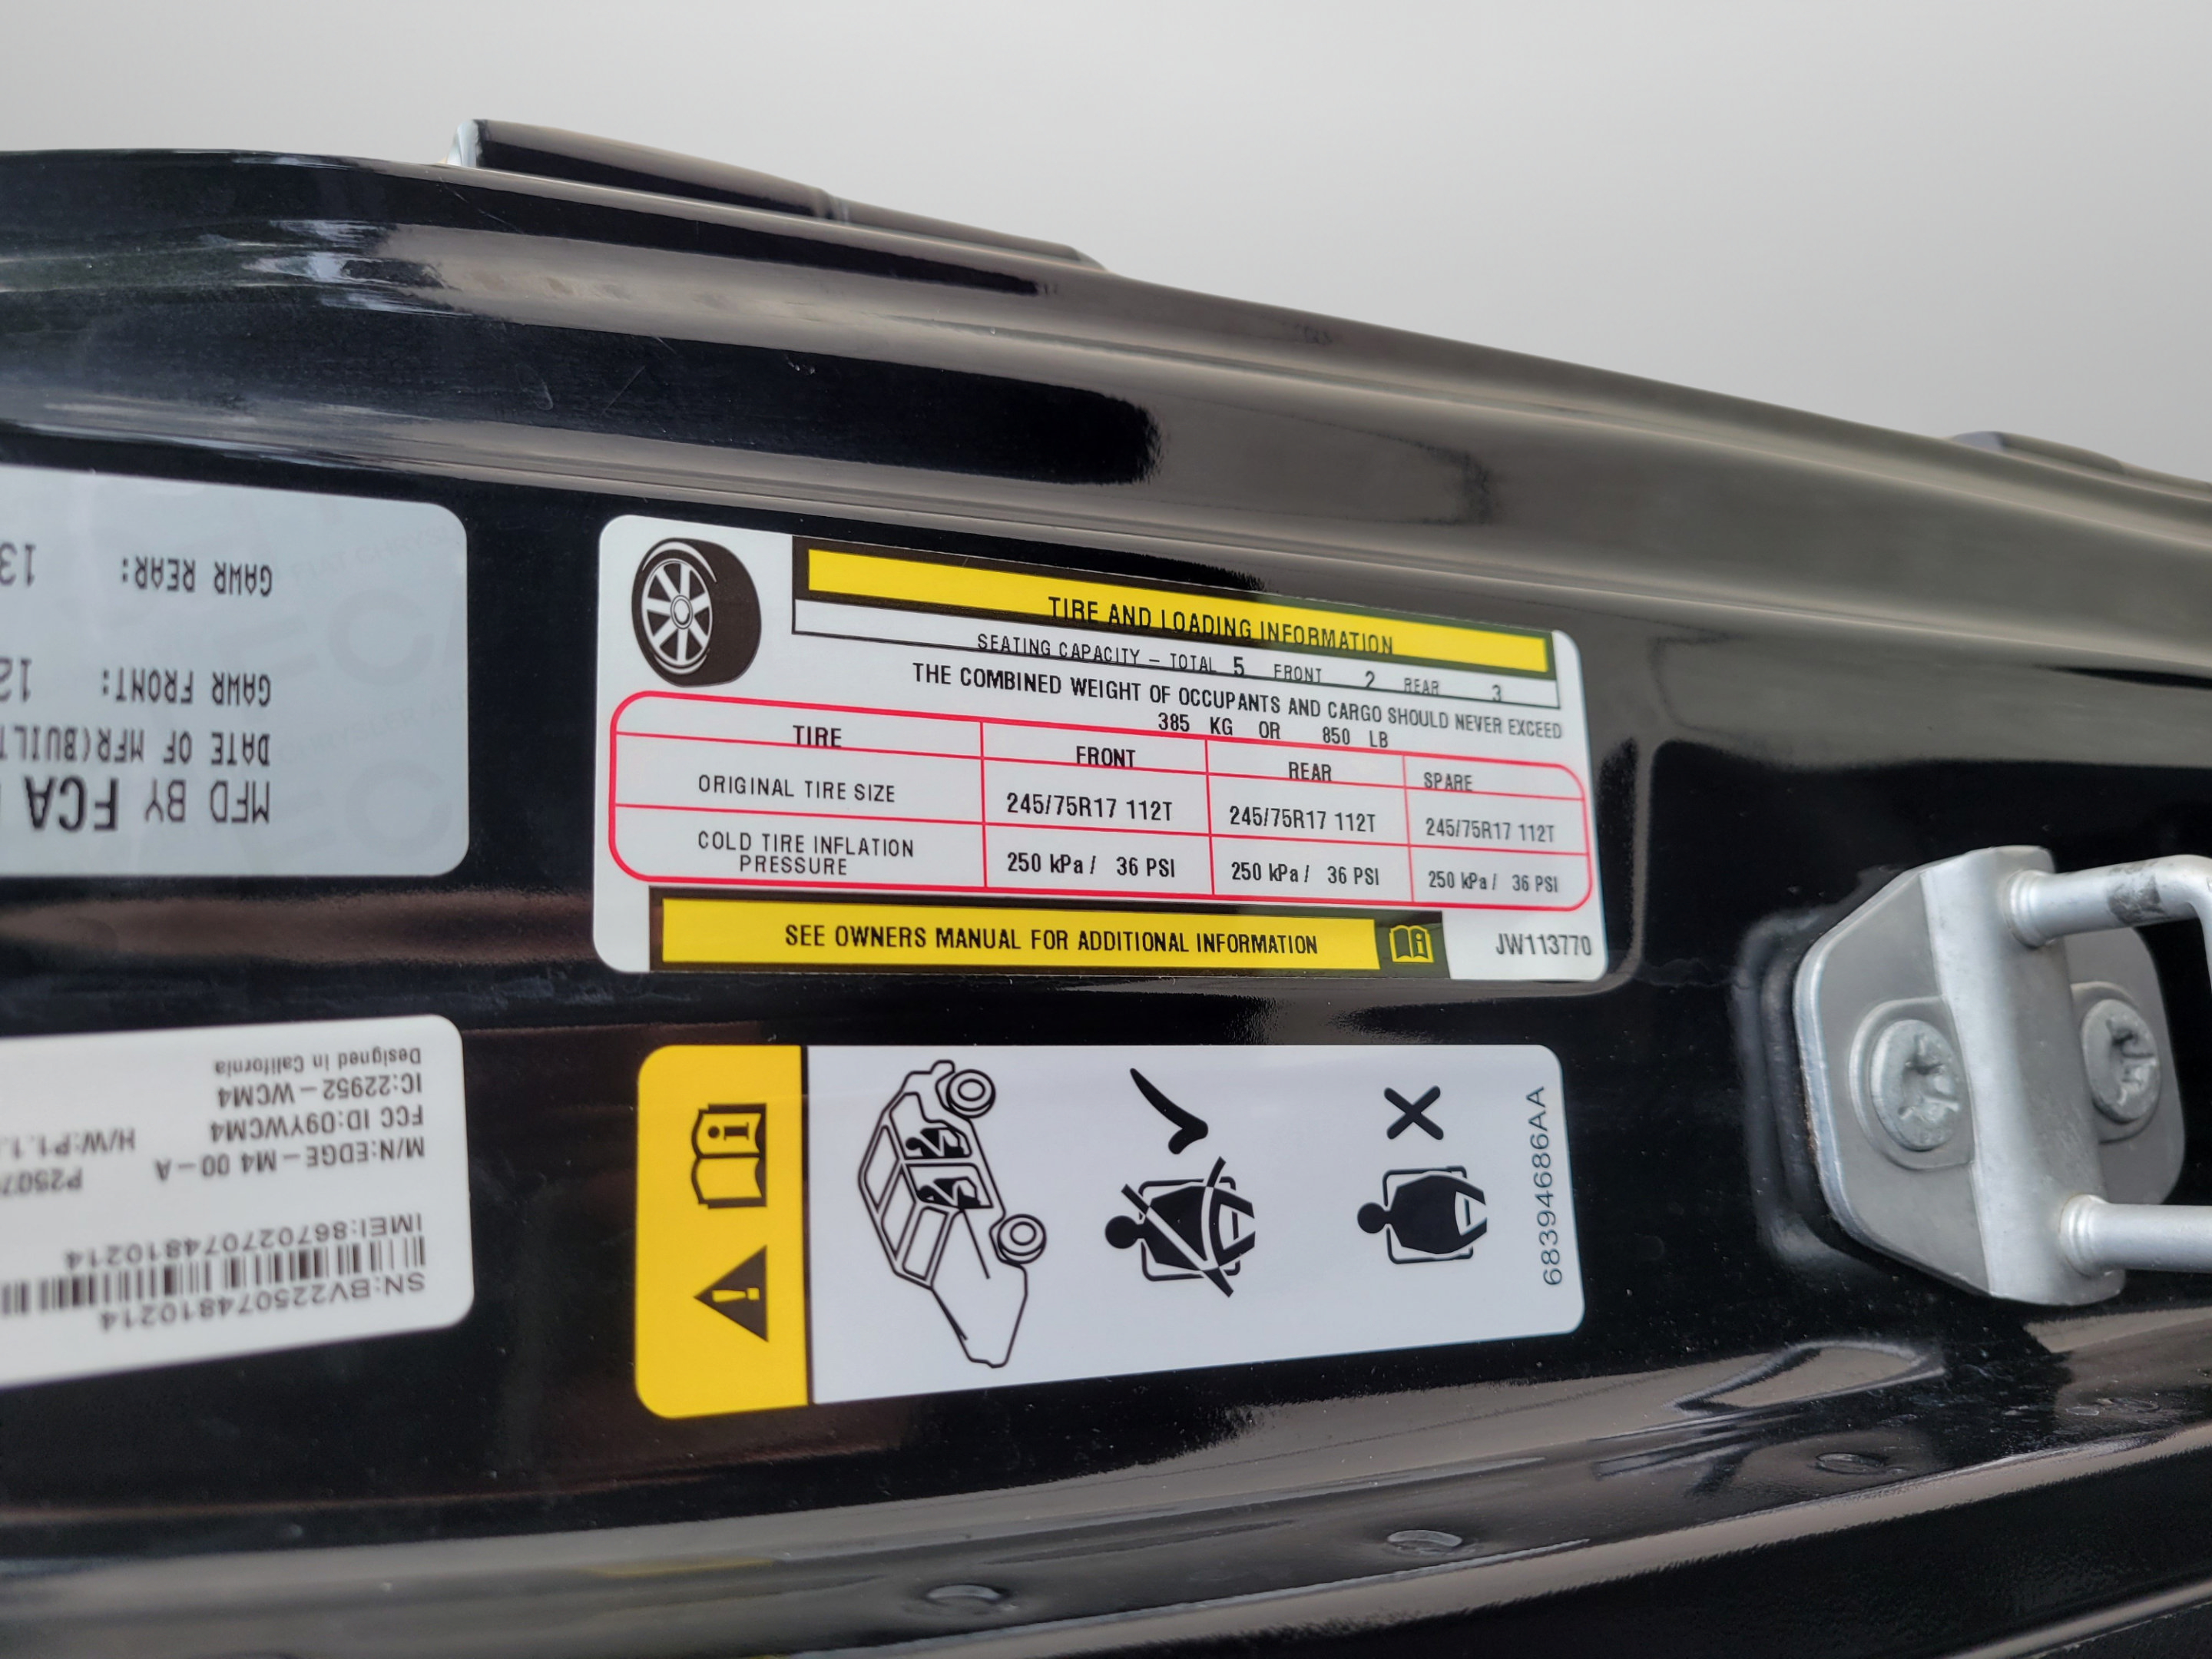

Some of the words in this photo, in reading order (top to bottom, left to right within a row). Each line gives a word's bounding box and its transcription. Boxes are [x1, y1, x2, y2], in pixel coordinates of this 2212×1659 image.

[121, 556, 195, 593] REAR:
[214, 562, 273, 598] GAWR
[1048, 597, 1098, 623] TIRE
[1109, 604, 1151, 628] AND
[1161, 609, 1252, 638] LOADING
[1261, 620, 1394, 654] INFORMATION
[978, 634, 1051, 657] SEATING
[1059, 642, 1140, 665] CAPACITY
[1171, 653, 1217, 674] TOTAL
[1233, 657, 1244, 677] 5
[1274, 664, 1322, 684] FRONT
[1365, 671, 1375, 689] 2
[1405, 678, 1439, 696] REAR
[1492, 684, 1502, 702] 3
[101, 667, 194, 704] FRONT:
[212, 672, 271, 707] GAWR
[913, 663, 952, 685] THE
[960, 668, 1061, 694] COMBINED
[1071, 679, 1141, 702] WEIGHT
[1150, 684, 1171, 703] OF
[1178, 687, 1280, 714] OCCUPANTS
[1289, 697, 1320, 717] AND
[1328, 701, 1382, 723] CARGO
[1388, 707, 1448, 729] SHOULD
[1455, 714, 1502, 734] NEVER
[1508, 718, 1562, 740] EXCEED
[793, 725, 842, 748] TIRE
[1158, 713, 1190, 733] 385
[1210, 717, 1233, 737] KG
[1259, 721, 1280, 740] OR
[1323, 727, 1350, 746] 850
[1370, 730, 1388, 748] LB
[163, 730, 192, 765] OF
[211, 731, 270, 767] DATE
[1076, 745, 1135, 768] FRONT
[1289, 762, 1332, 782] REAR
[1423, 772, 1472, 791] SPARE
[144, 779, 186, 823] BY
[210, 780, 270, 823] MFD
[698, 774, 794, 797] ORIGINAL
[805, 780, 846, 800] TIRE
[854, 783, 895, 803] SIZE
[25, 775, 118, 832] FCA
[1007, 793, 1116, 819] 245/75R17
[1126, 800, 1172, 822] 112T
[1230, 806, 1326, 830] 245/75R17
[1334, 812, 1375, 833] 112T
[1426, 819, 1511, 841] 245/75R17
[1518, 824, 1555, 843] 112T
[698, 831, 751, 851] COLD
[762, 833, 804, 853] TIRE
[813, 836, 914, 857] INFLATION
[740, 856, 847, 875] PRESSURE
[1007, 853, 1041, 873] 250
[1116, 857, 1139, 876] 36
[1146, 858, 1175, 878] PSI
[1231, 863, 1261, 881] 250
[1327, 867, 1346, 885] 36
[1354, 867, 1379, 886] PSI
[1429, 871, 1454, 889] 250
[1512, 875, 1529, 892] 36
[1535, 875, 1558, 893] PSI
[785, 924, 825, 946] SEE
[835, 926, 926, 948] OWNERS
[935, 928, 1022, 949] MANUAL
[1031, 929, 1068, 950] FOR
[1078, 931, 1189, 952] ADDITIONAL
[1197, 932, 1318, 955] INFORMATION
[1496, 934, 1591, 956] JW113770
[214, 1054, 304, 1075] California
[313, 1054, 330, 1070] in
[338, 1047, 422, 1069] Designed
[381, 1105, 424, 1127] FCC
[1525, 1086, 1562, 1286] 68394686AA
